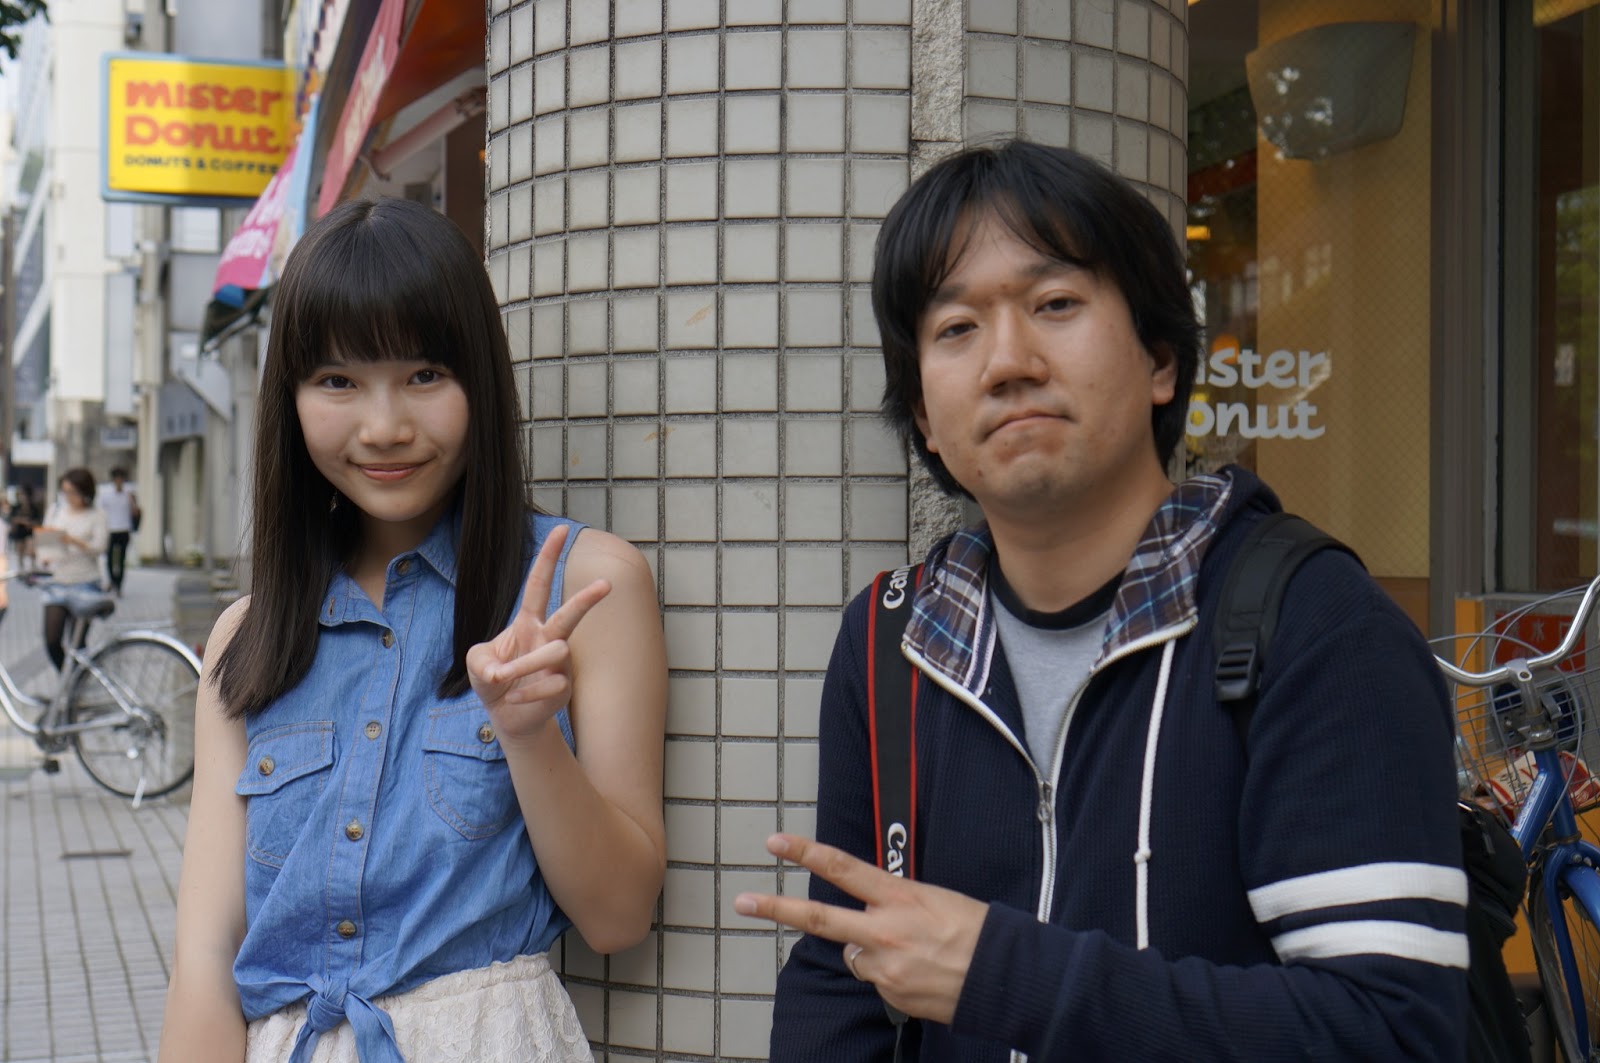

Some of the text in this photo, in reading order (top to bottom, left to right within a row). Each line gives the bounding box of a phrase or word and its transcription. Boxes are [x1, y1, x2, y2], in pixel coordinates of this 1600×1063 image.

[125, 114, 281, 154] Donut
[124, 153, 191, 168] DONUTS
[196, 157, 205, 170] &
[1195, 347, 1326, 389] ister
[1186, 400, 1325, 439] onut
